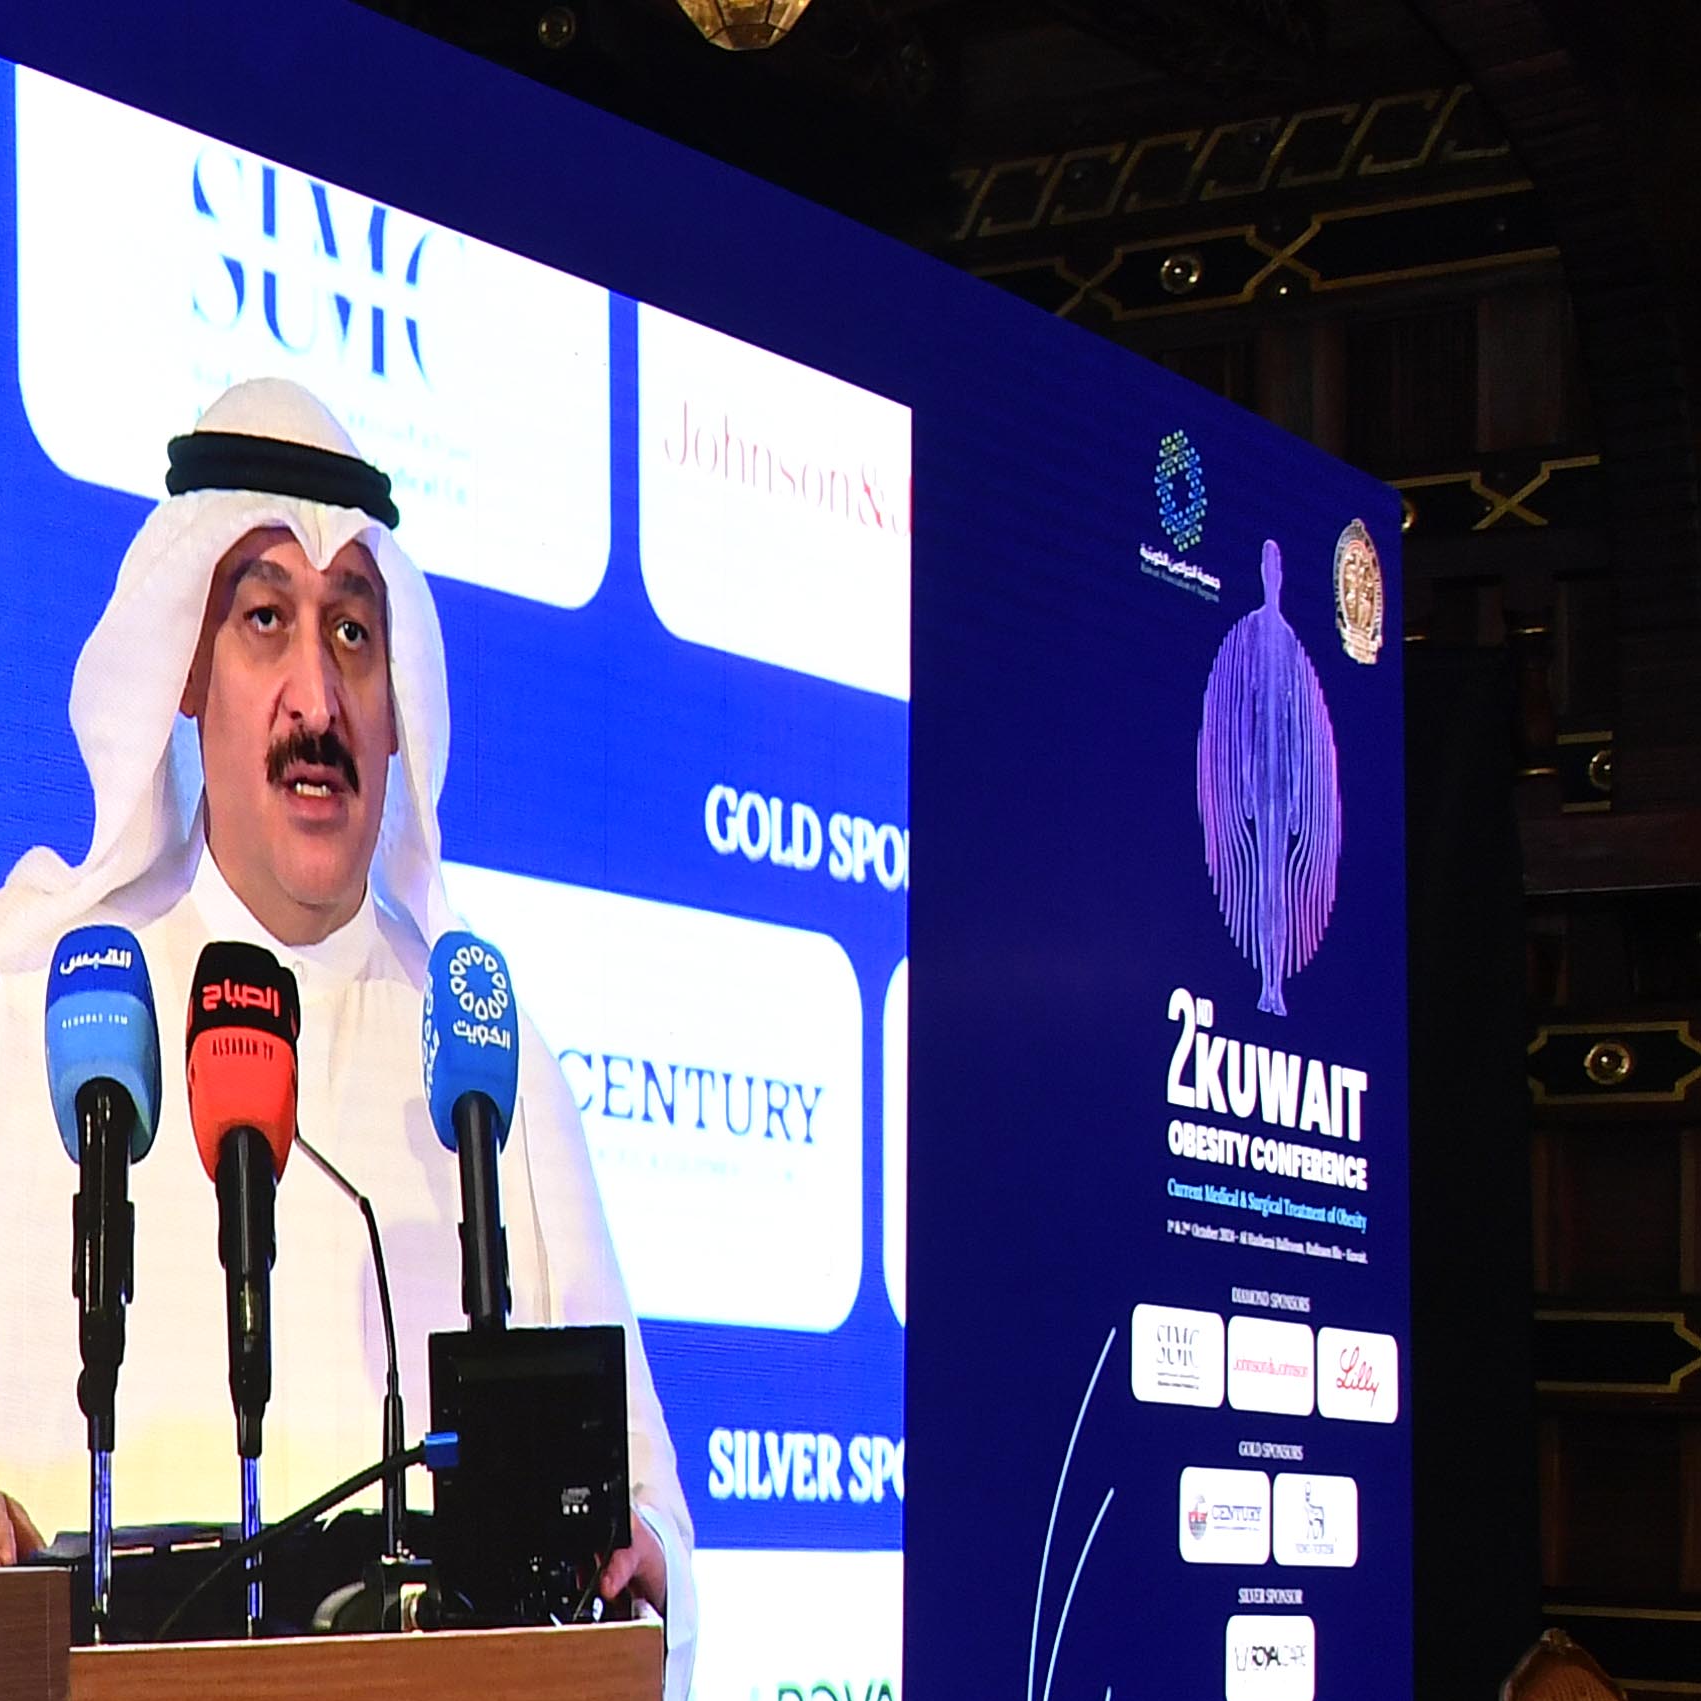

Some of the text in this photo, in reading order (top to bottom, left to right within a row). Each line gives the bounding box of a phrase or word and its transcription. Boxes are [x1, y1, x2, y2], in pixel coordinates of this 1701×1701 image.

[705, 784, 822, 869] GOLD
[202, 978, 281, 1018] الصباح
[1195, 1031, 1368, 1142] KUWAIT
[1168, 1119, 1368, 1191] OBESITY CONFERENCE
[1336, 1346, 1380, 1408] Lilly
[708, 1427, 842, 1501] SILVER
